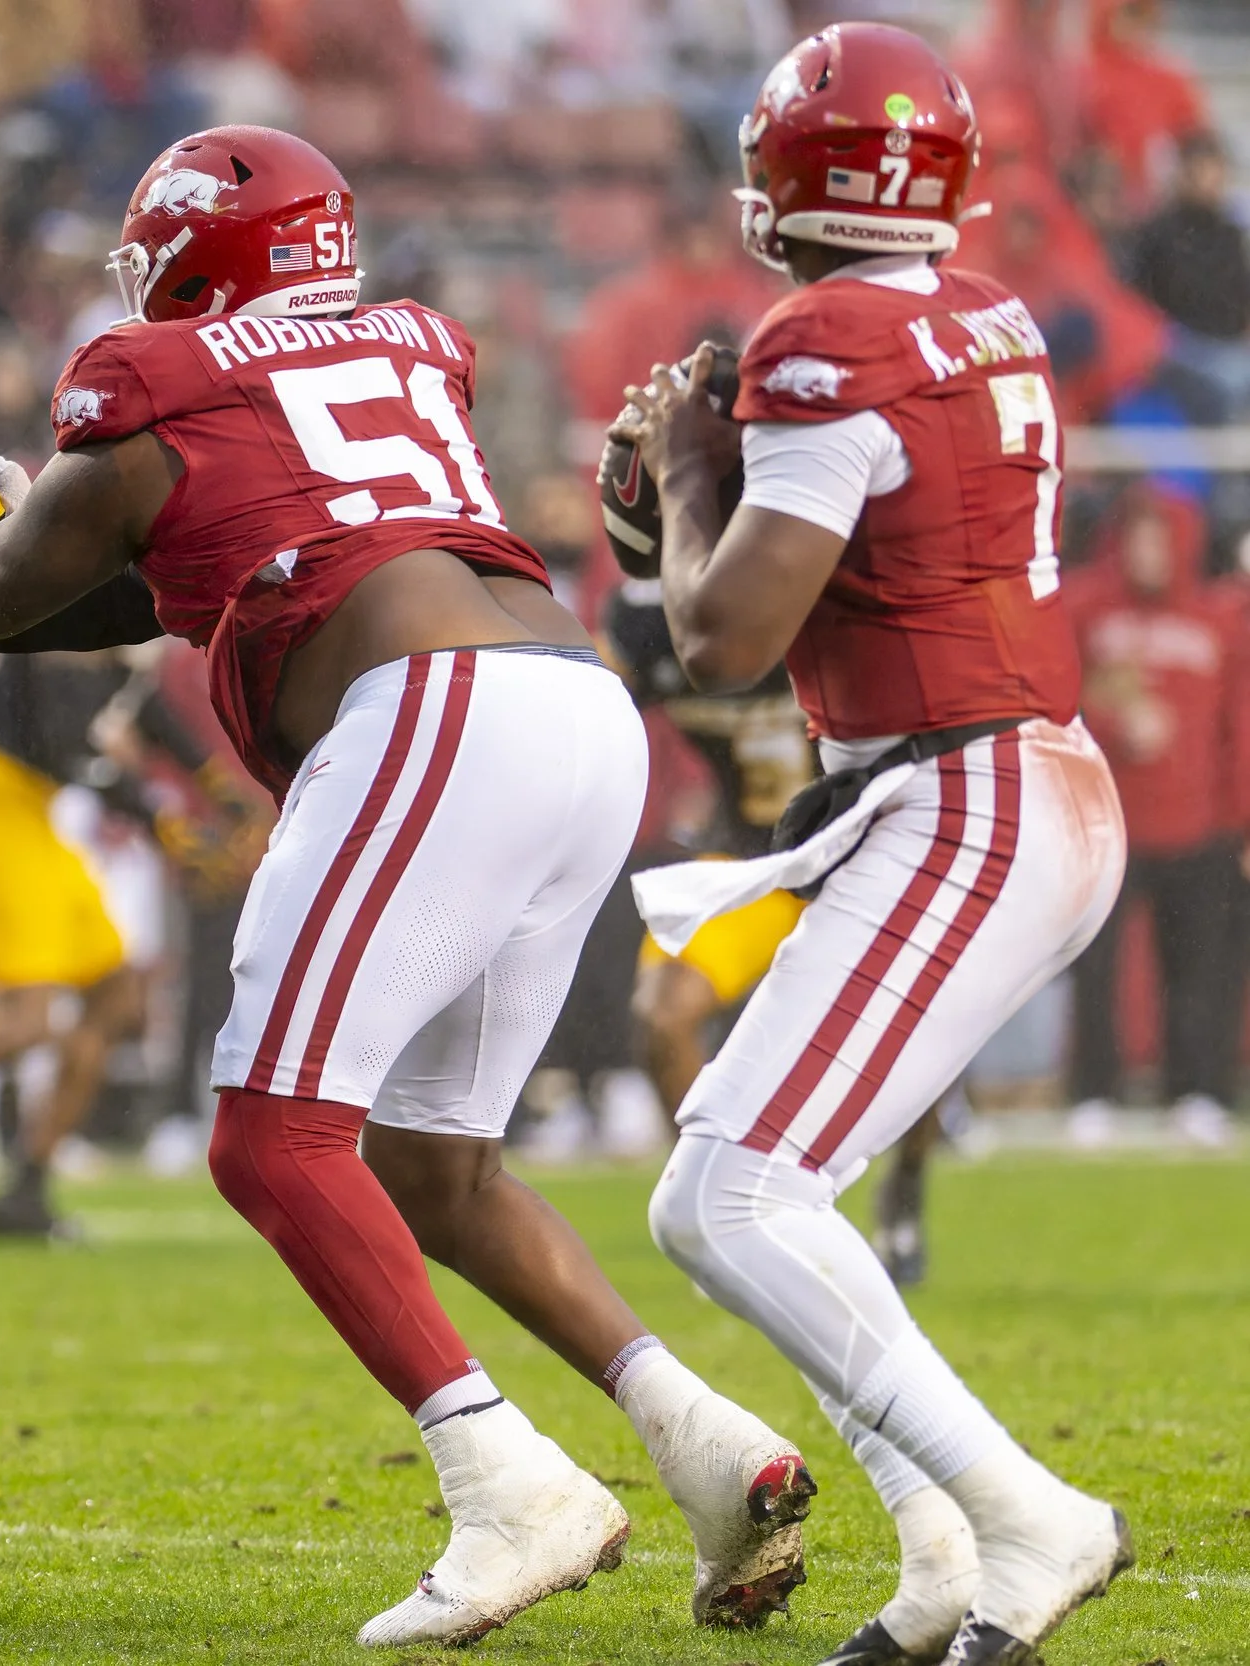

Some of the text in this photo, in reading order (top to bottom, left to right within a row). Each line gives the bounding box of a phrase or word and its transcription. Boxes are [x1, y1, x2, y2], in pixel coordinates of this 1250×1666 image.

[880, 155, 911, 207] 7
[315, 221, 351, 269] 51
[822, 222, 935, 243] RAZORBACKS
[196, 308, 430, 371] ROBINSON
[907, 315, 967, 383] K.
[267, 356, 509, 533] 51
[987, 372, 1063, 601] 7
